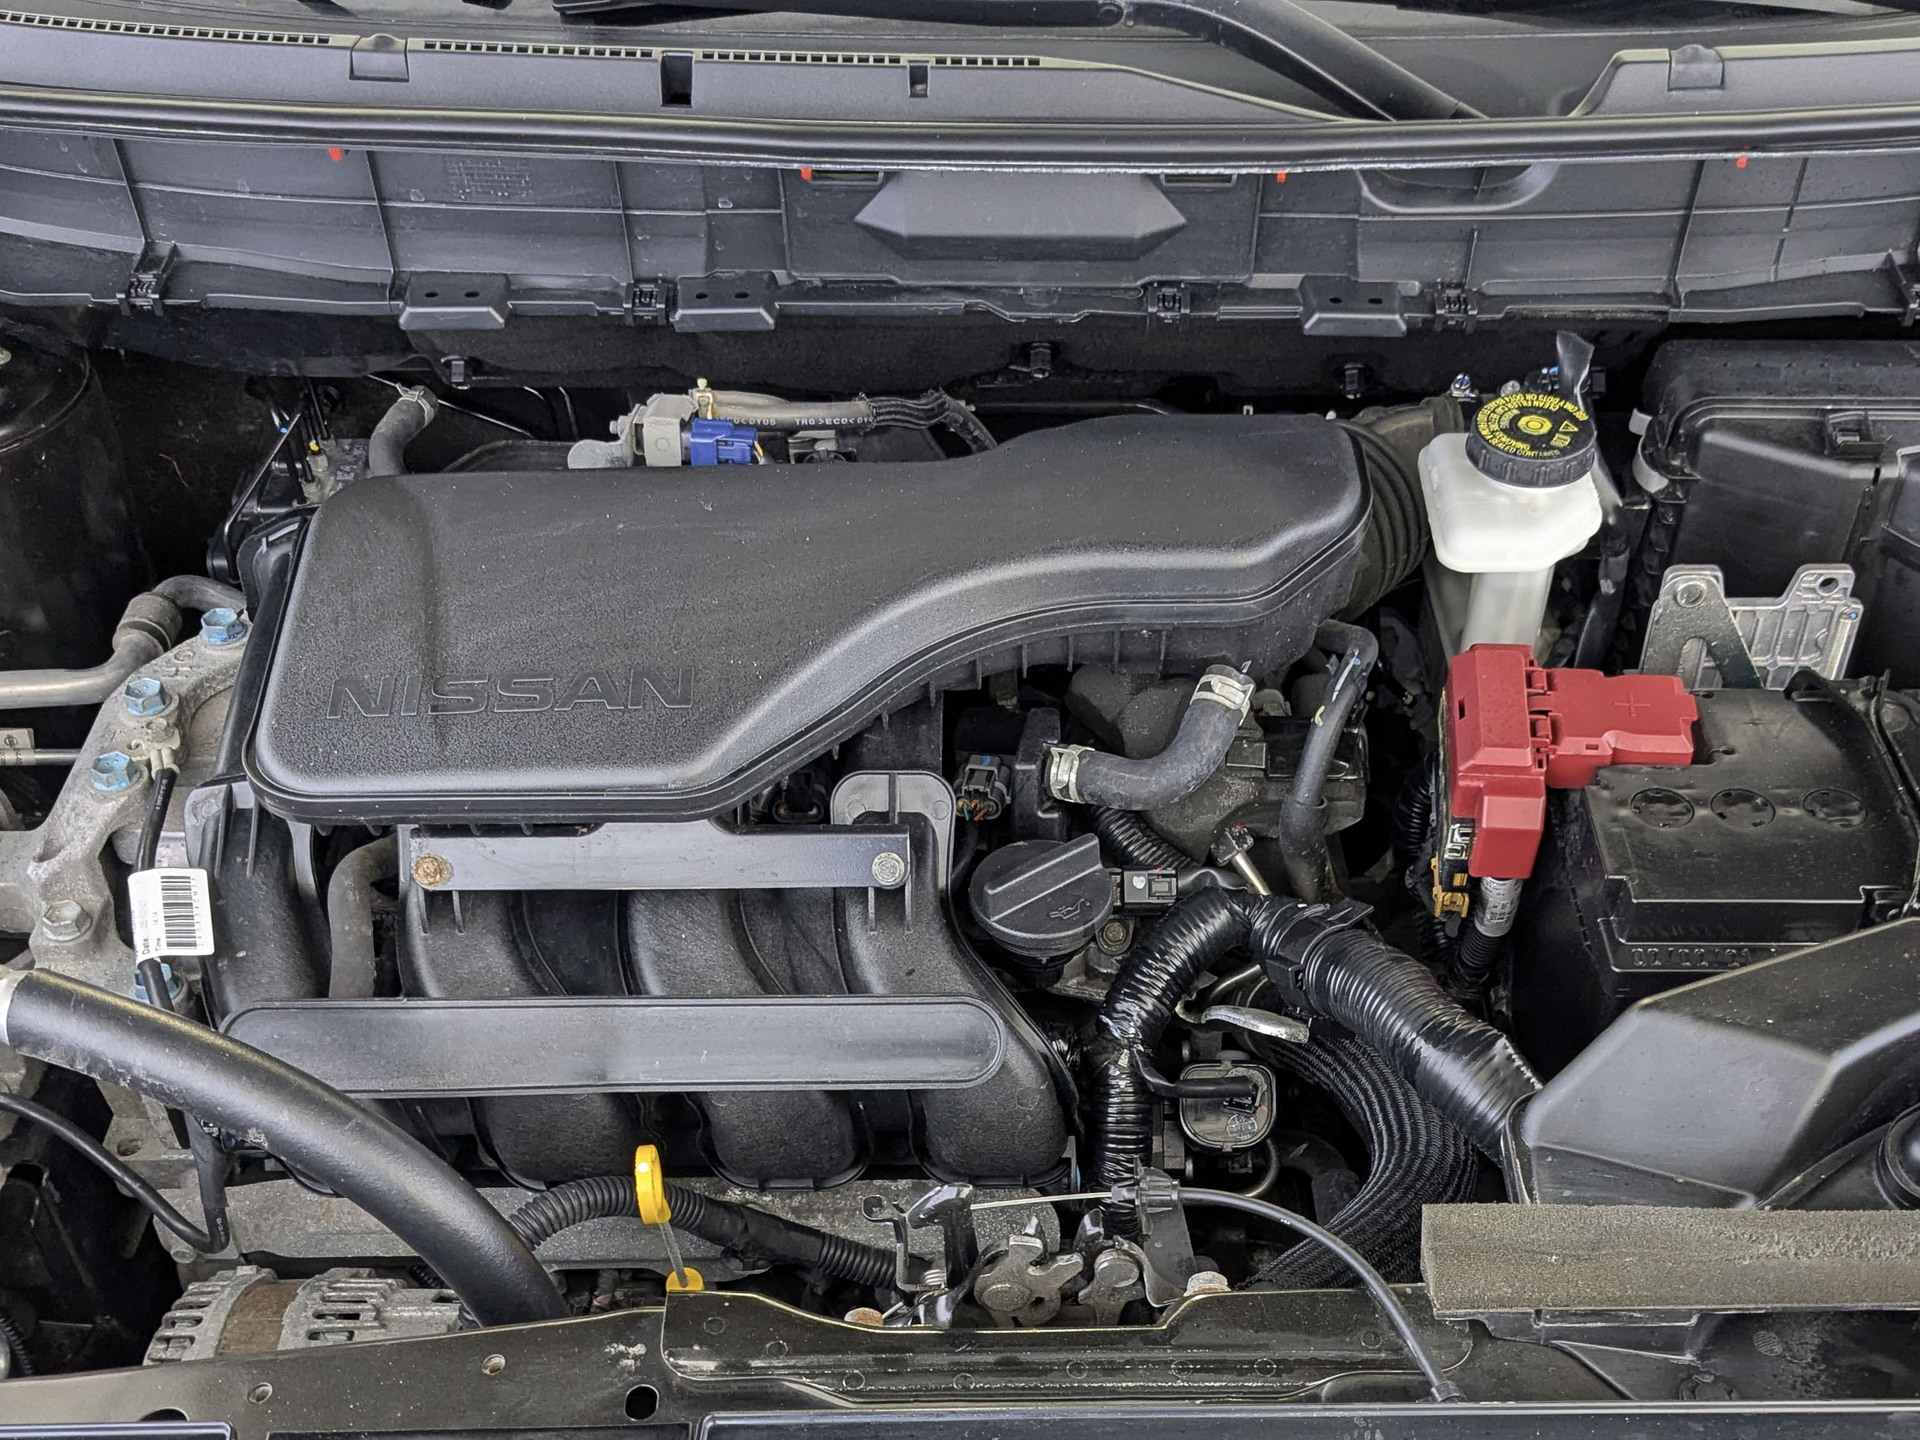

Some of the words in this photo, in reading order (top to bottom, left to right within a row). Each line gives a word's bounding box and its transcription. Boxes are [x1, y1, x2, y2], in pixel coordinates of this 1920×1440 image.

[1525, 393, 1537, 401] OR
[1533, 400, 1560, 412] CLEAN
[795, 418, 816, 426] TRG
[1489, 439, 1517, 454] SEALED
[326, 666, 695, 719] NISSAN
